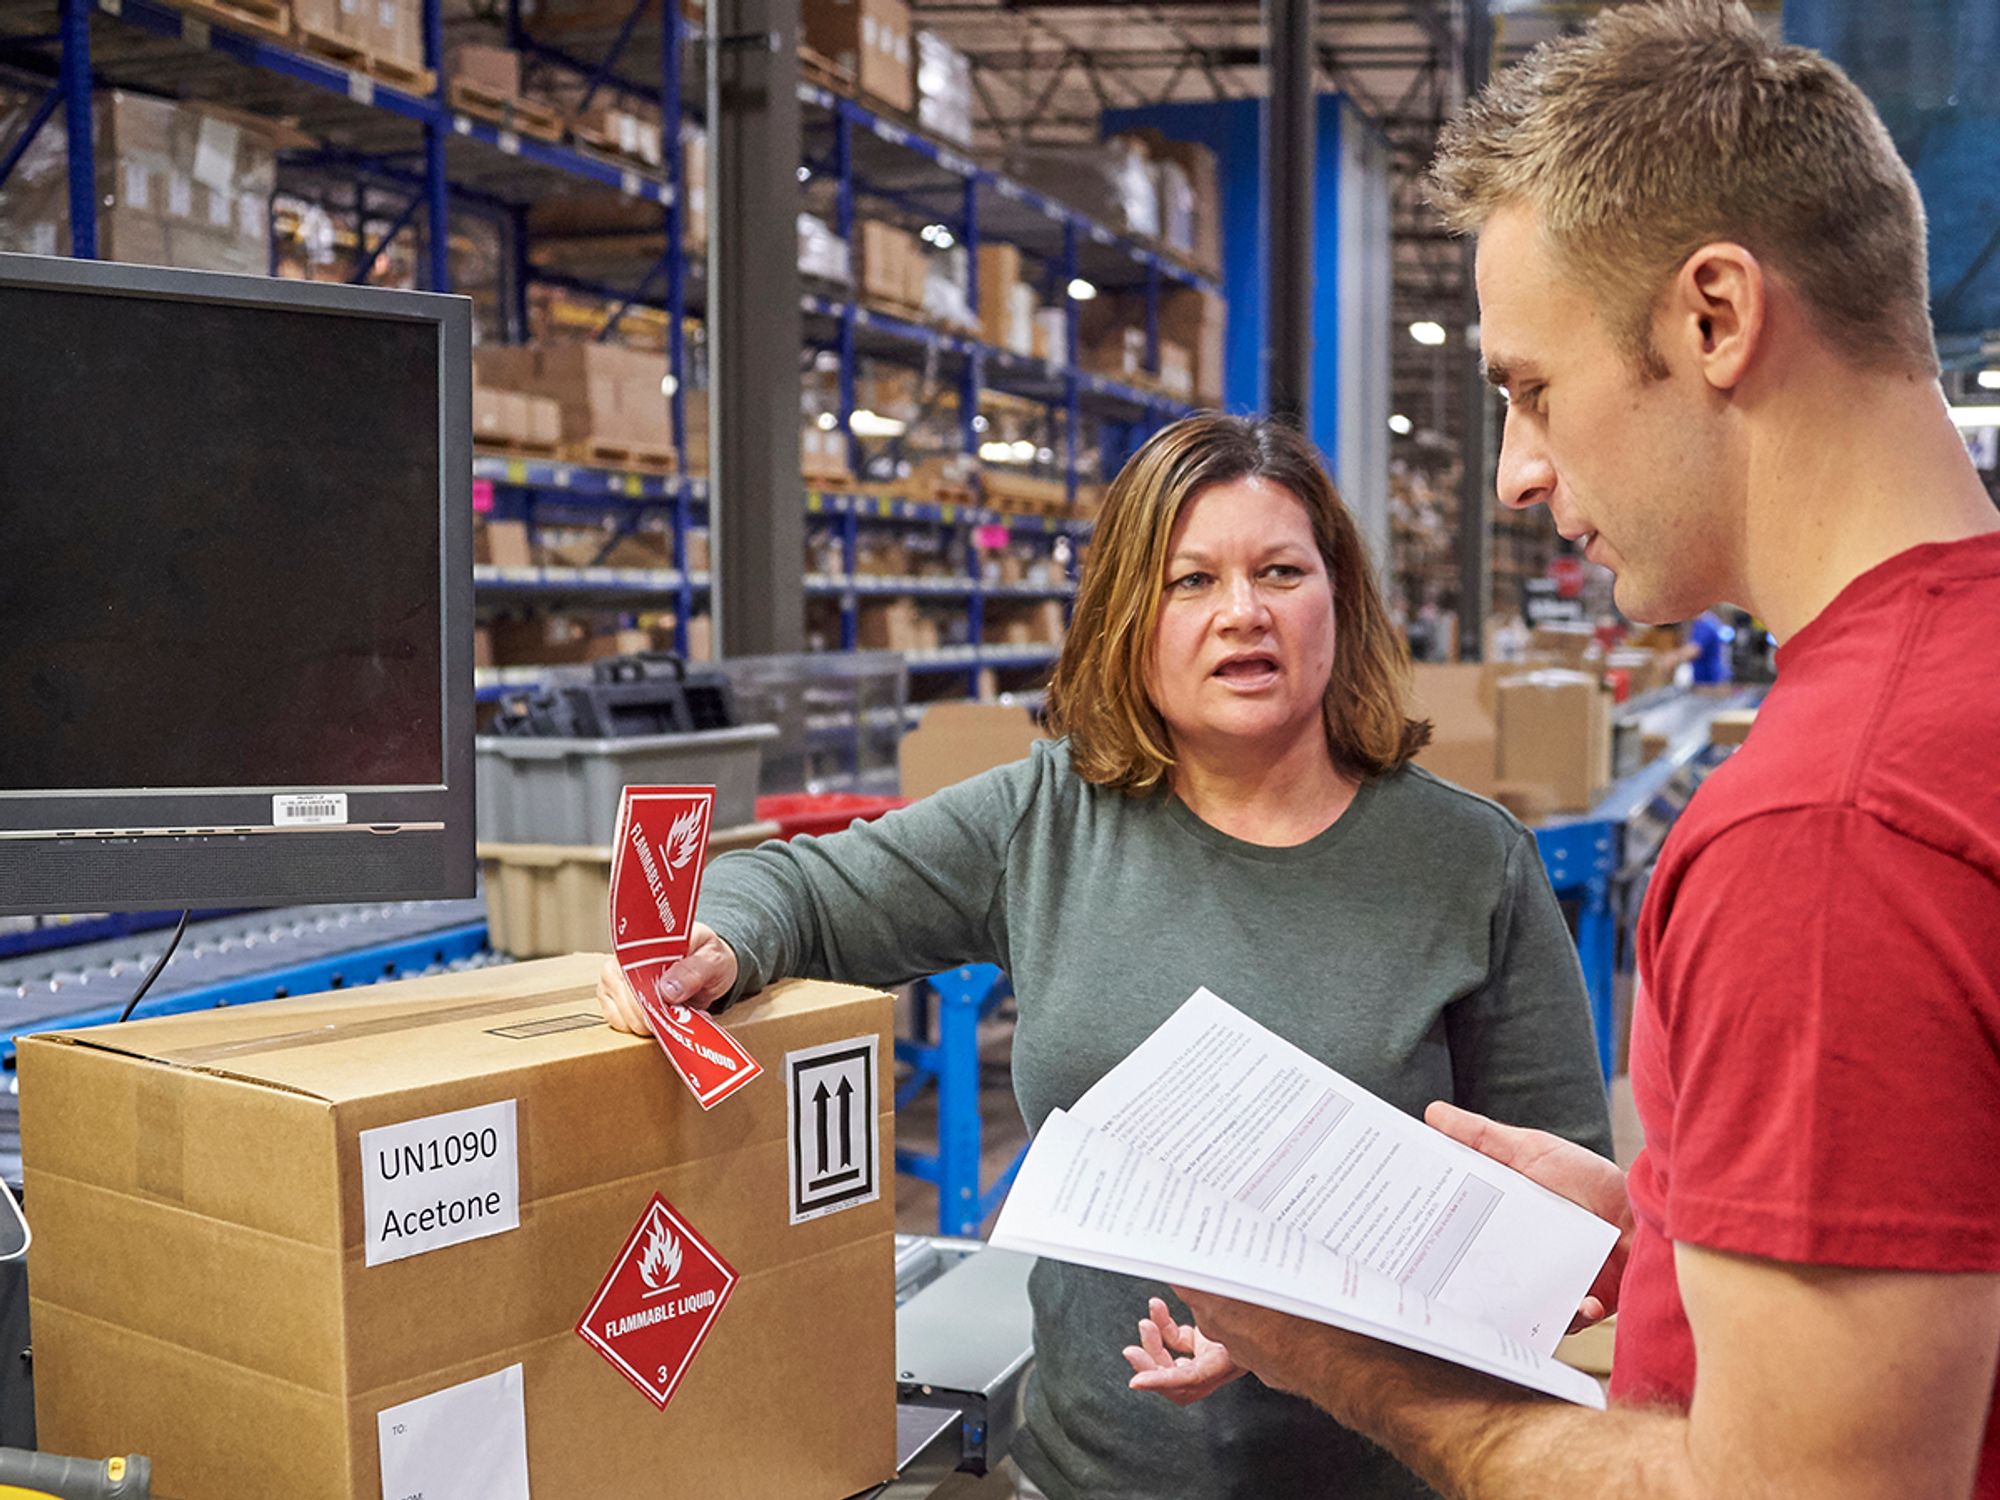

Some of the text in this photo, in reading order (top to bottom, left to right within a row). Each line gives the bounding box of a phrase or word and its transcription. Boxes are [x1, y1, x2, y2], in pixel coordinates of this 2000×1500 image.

[630, 822, 676, 933] FLAMMABLE LIQUID
[619, 917, 627, 935] 3
[694, 1042, 737, 1071] LIQUID
[380, 1127, 497, 1180] UN1090
[381, 1192, 501, 1242] Acetone
[605, 1289, 716, 1339] FLAMMABLE LIQUID
[657, 1364, 668, 1384] 3
[391, 1423, 407, 1436] TO:
